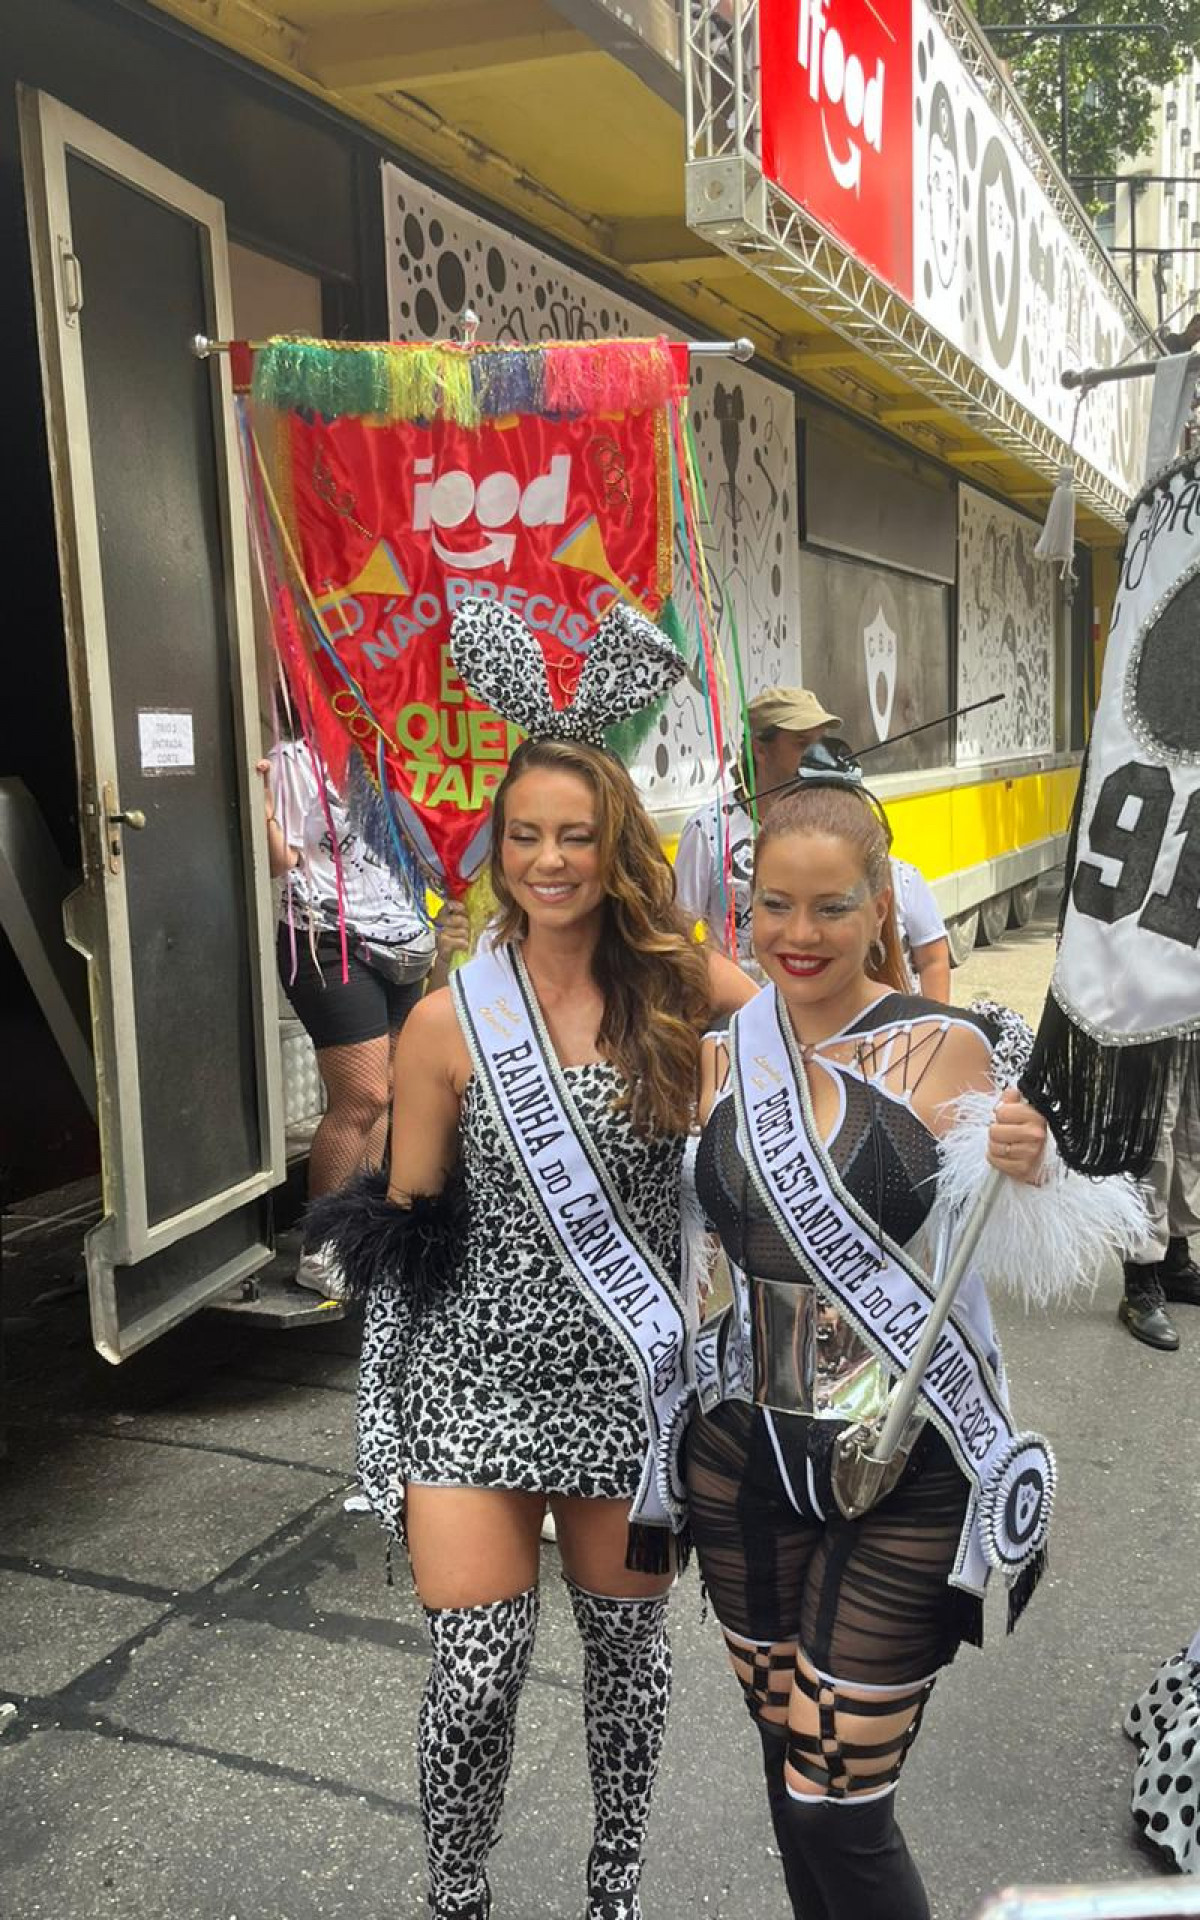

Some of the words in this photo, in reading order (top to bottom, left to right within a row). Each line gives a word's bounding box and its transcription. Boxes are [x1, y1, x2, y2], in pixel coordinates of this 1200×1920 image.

[361, 594, 441, 669] NÃO
[445, 577, 597, 654] PRECIS
[492, 1040, 565, 1157] RAINHA
[538, 1158, 572, 1195] DO
[753, 1086, 797, 1163] PORTA
[771, 1151, 881, 1294] ESTANDARTE
[860, 1285, 892, 1319] DO
